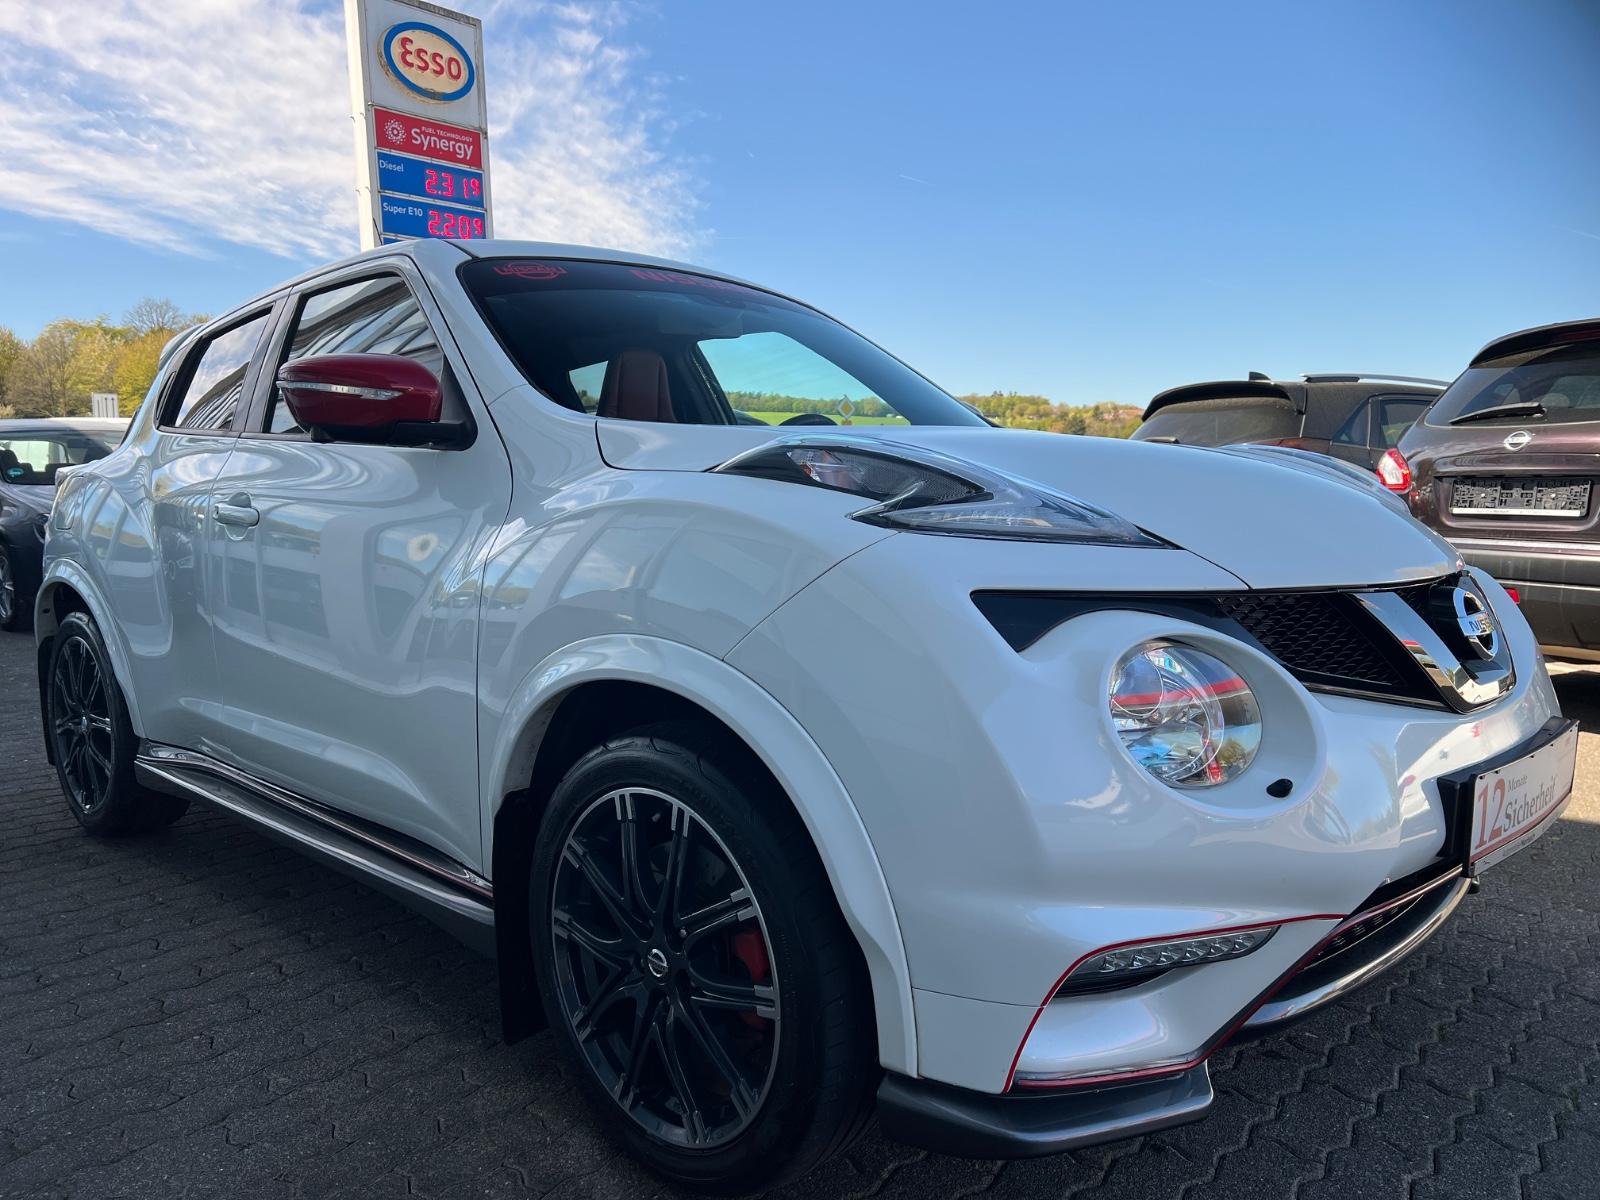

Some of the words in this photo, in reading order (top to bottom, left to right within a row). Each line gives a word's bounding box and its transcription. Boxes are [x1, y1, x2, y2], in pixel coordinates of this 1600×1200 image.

[411, 127, 473, 160] Synergy
[379, 159, 404, 172] Diesel
[382, 202, 407, 215] Super
[407, 206, 424, 217] E10
[1503, 774, 1556, 833] Sicherheit
